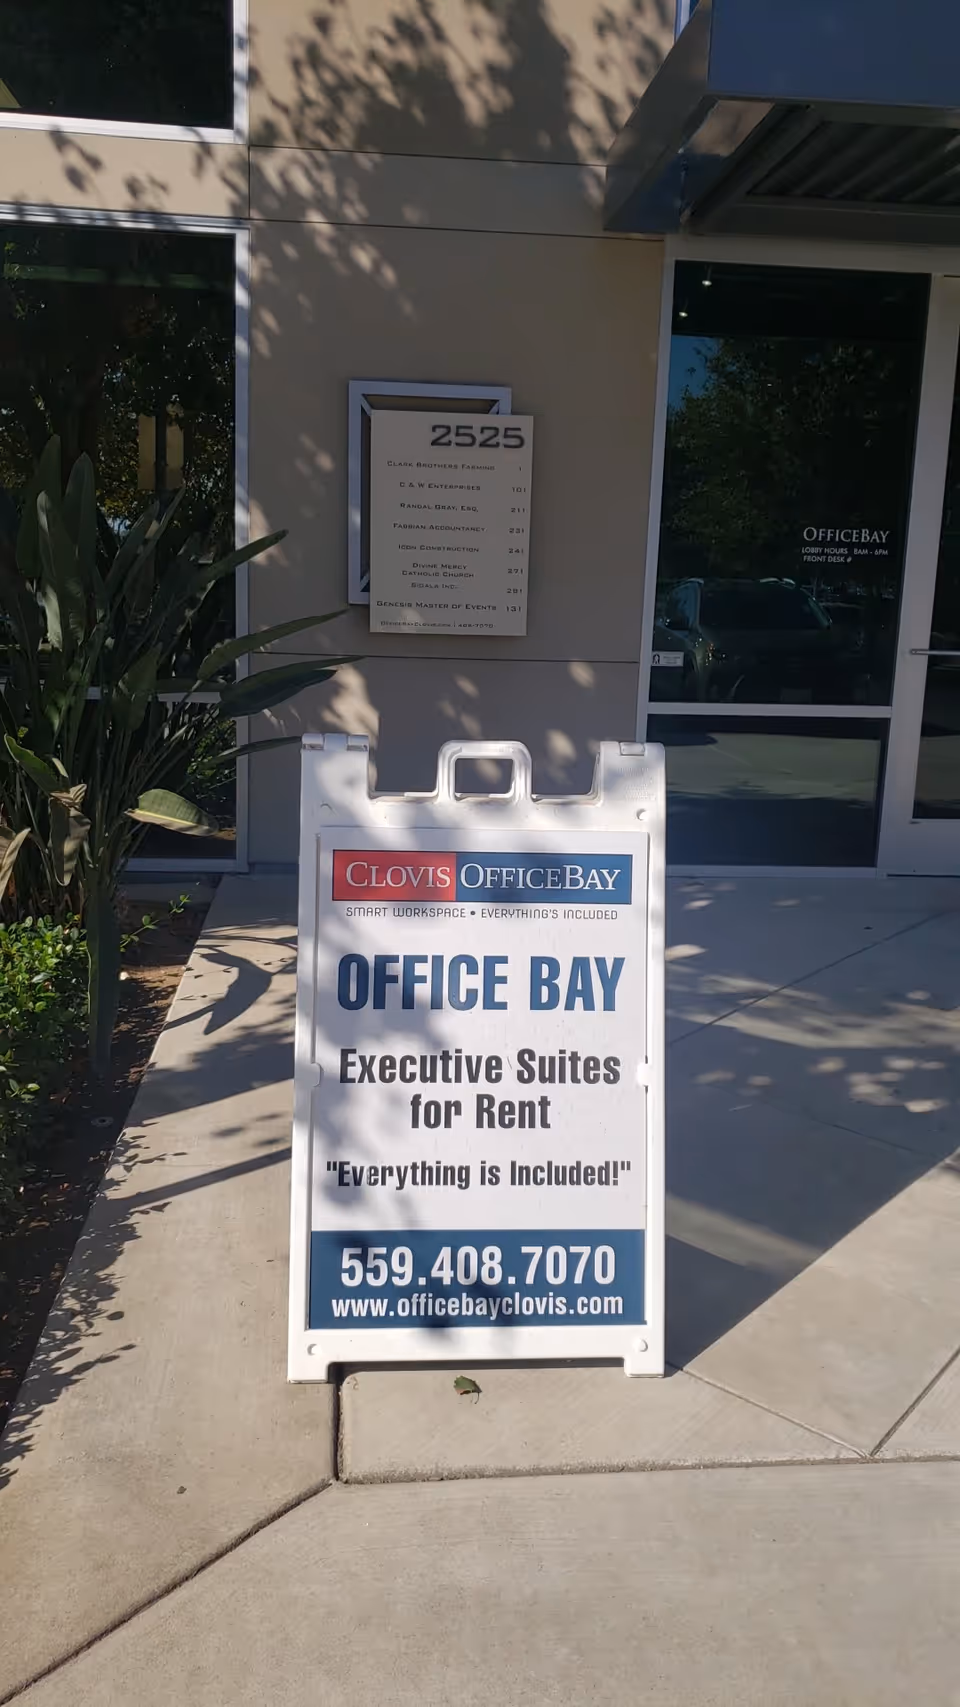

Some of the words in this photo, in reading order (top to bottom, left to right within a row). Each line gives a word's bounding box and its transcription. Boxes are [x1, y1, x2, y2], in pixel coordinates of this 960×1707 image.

[431, 424, 525, 448] 2525
[428, 483, 481, 491] ENTERPRISES
[346, 861, 451, 888] CLOVIS
[346, 907, 388, 917] SMART
[392, 908, 466, 918] WORKSPACE
[481, 909, 559, 919] EVERYTHING'S
[563, 909, 618, 920] INCLUDED
[337, 953, 509, 1011] OFFICE
[529, 955, 626, 1012] BAY
[339, 1048, 503, 1084] Executive
[516, 1048, 621, 1084] Suites
[410, 1093, 462, 1129] for
[476, 1093, 551, 1129] Rent
[326, 1161, 471, 1190] "Everything
[480, 1161, 501, 1186] is
[510, 1160, 631, 1186] Included!"
[341, 1245, 616, 1287] 559.408.7070
[331, 1291, 624, 1321] www.officebayclovis.com
